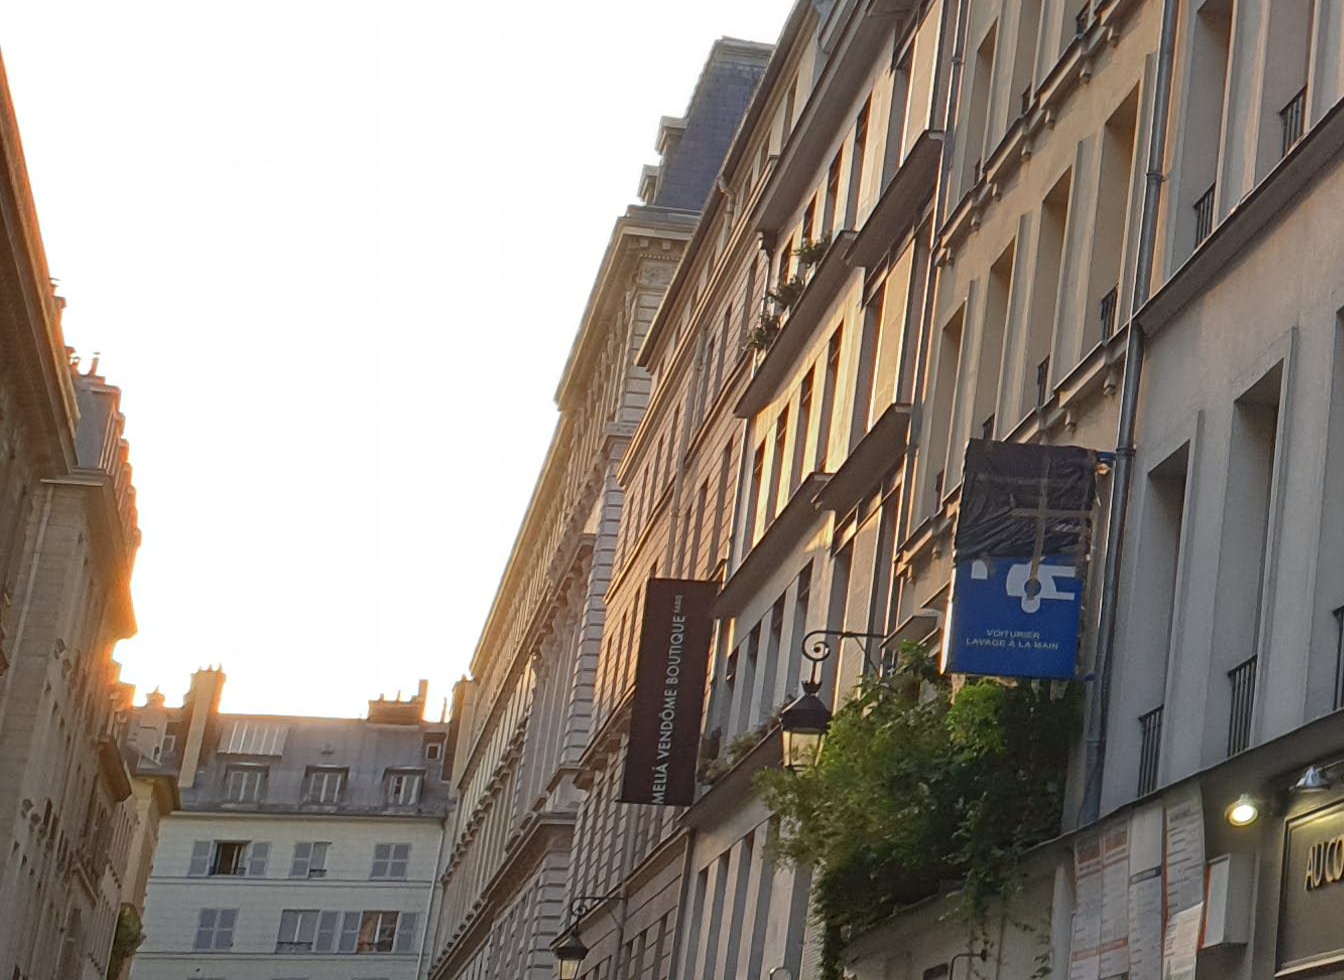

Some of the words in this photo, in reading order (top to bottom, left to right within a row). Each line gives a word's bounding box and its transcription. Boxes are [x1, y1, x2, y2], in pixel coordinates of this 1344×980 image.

[666, 615, 686, 685] BOUTIQUE
[966, 638, 1005, 648] LAVAGE
[1019, 640, 1032, 649] LA
[1034, 641, 1059, 651] MAIN
[986, 629, 1040, 639] VOITURIER
[657, 689, 677, 761] VENDÔME
[1304, 842, 1325, 891] AU
